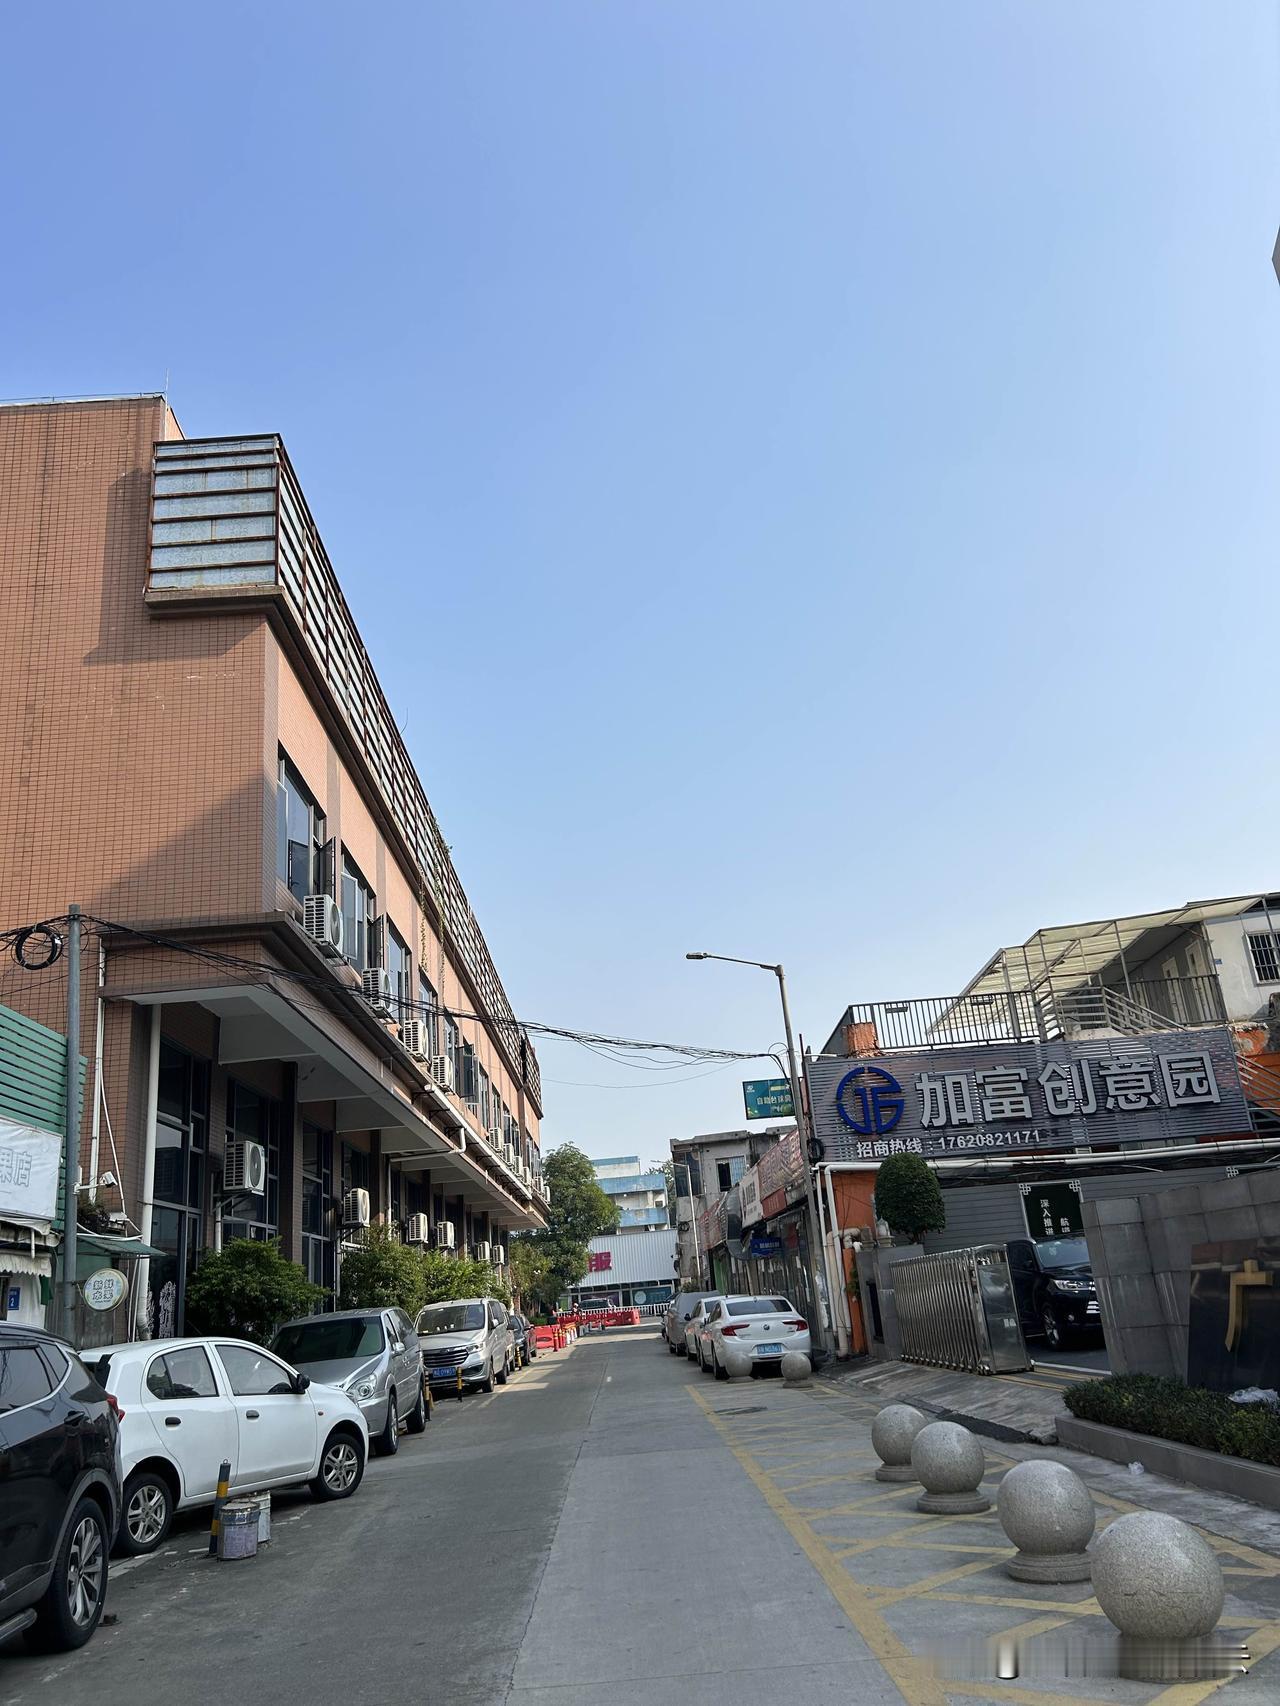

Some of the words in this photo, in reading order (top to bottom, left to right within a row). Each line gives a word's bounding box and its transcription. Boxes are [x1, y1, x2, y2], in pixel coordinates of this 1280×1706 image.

[915, 1050, 1221, 1129] 加富创意园
